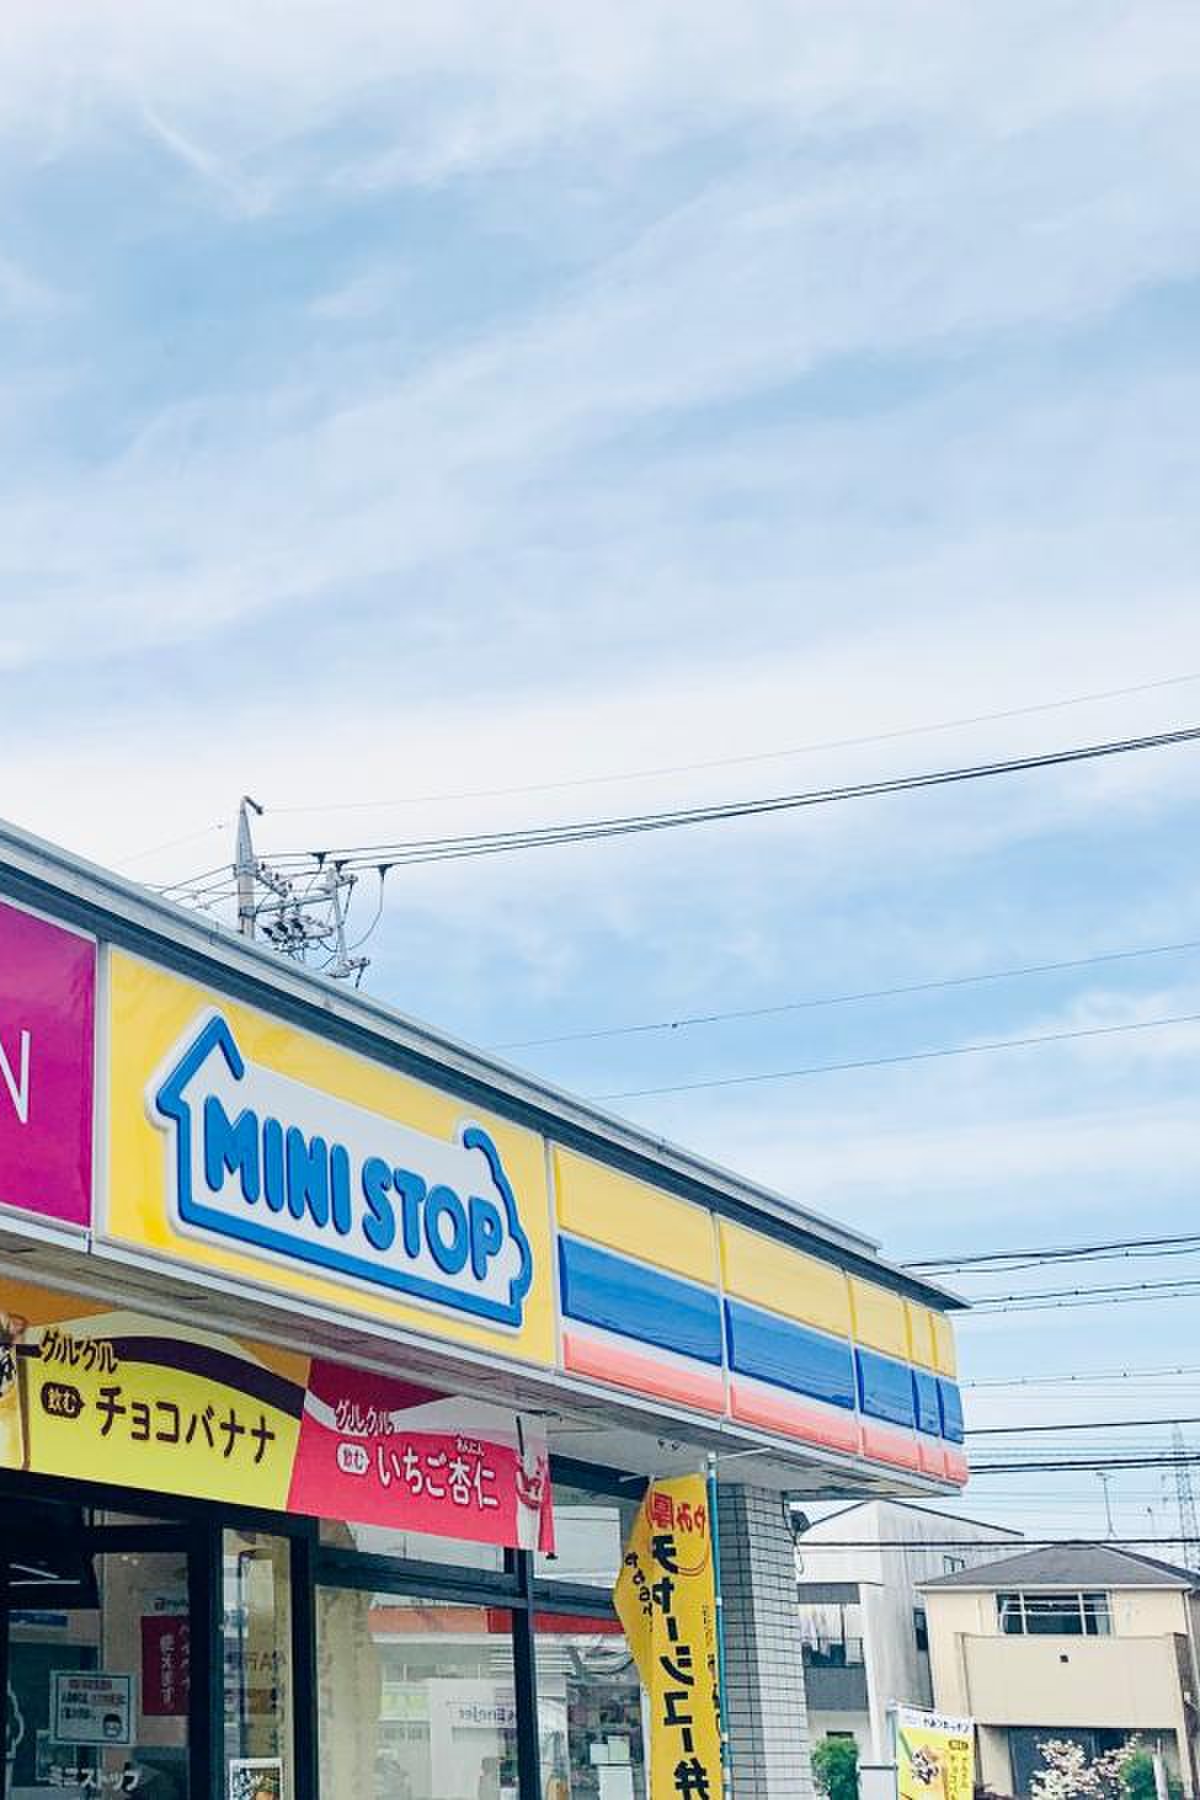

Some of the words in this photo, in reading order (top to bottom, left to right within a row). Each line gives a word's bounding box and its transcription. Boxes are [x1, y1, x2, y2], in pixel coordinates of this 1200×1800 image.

[204, 1094, 353, 1235] MINI
[361, 1156, 504, 1281] STOP
[96, 1386, 276, 1464] チョコバナナ
[377, 1445, 500, 1509] いちご杏仁
